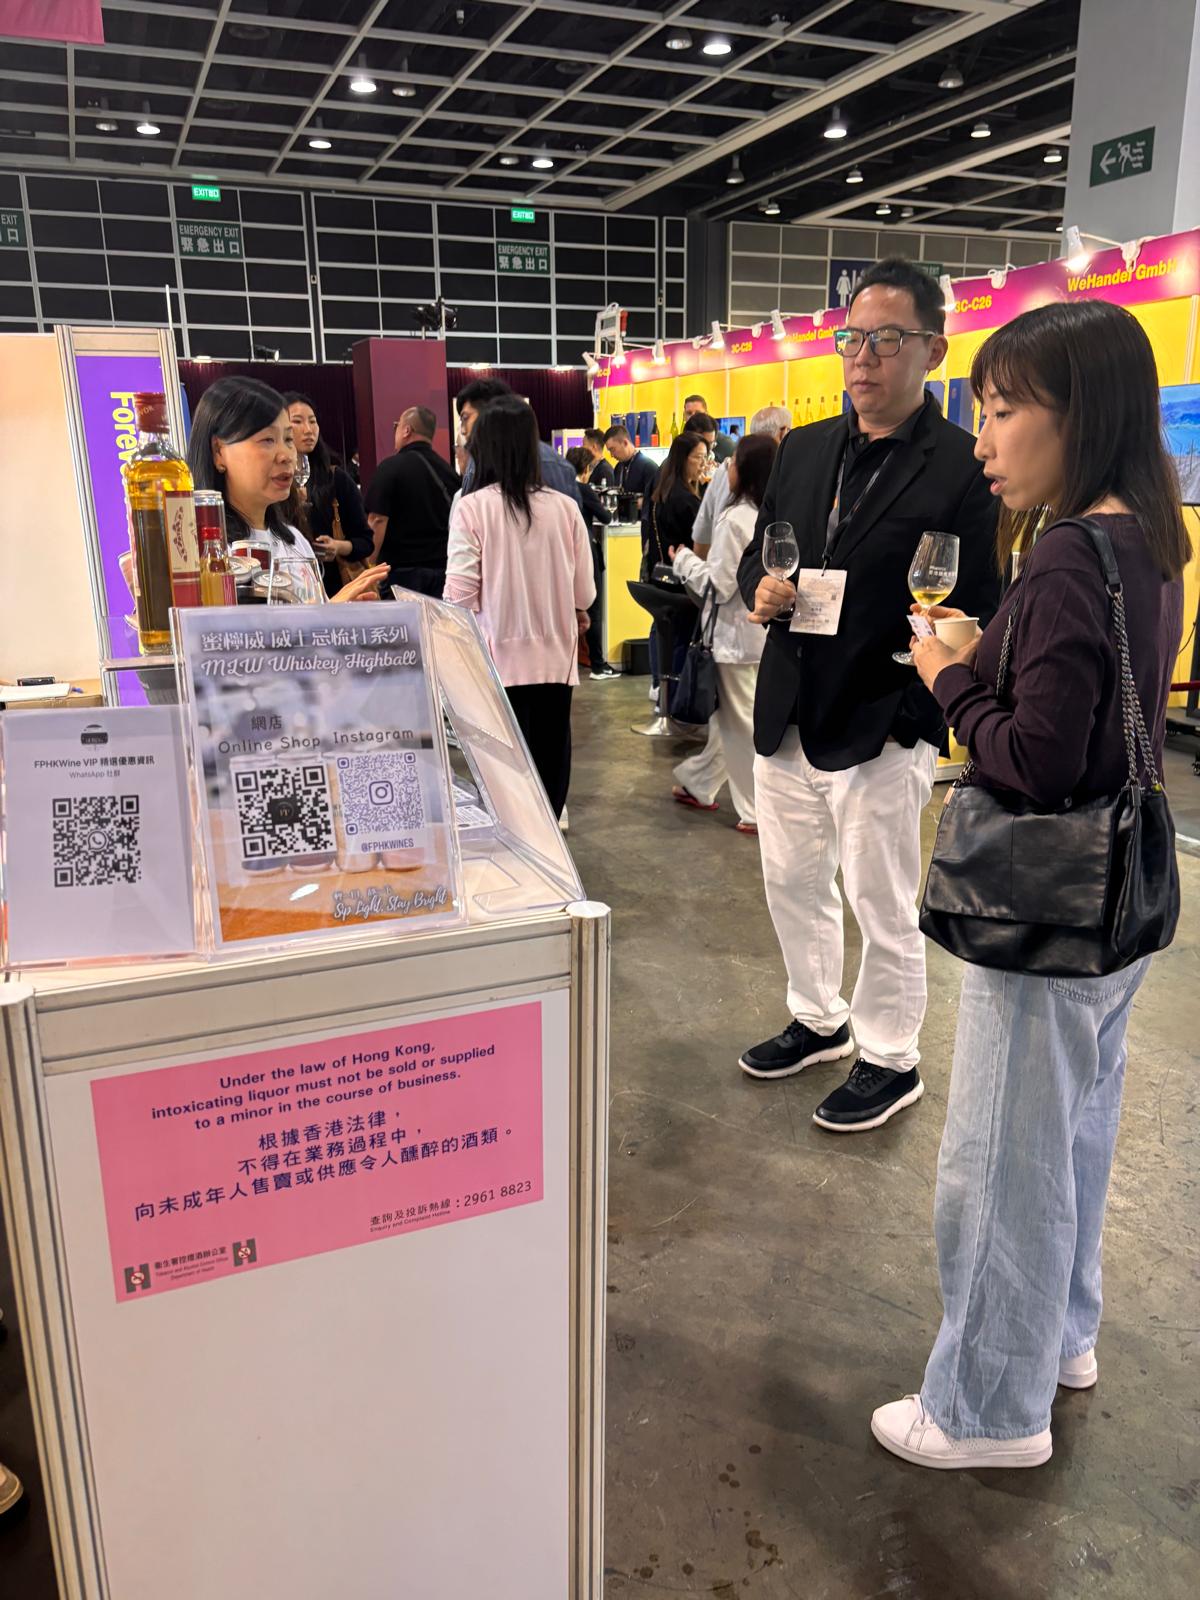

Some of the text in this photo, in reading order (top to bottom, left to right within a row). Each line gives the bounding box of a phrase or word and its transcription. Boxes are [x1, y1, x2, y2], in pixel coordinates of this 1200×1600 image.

[193, 187, 208, 197] EXIT
[1, 213, 17, 225] EXIT
[179, 224, 239, 238] EMERGENCY EXIT
[180, 236, 240, 255] 緊急出口
[498, 244, 548, 257] EMERGENCY EXIT
[498, 255, 548, 271] 緊急出口
[1067, 256, 1178, 293] WeHandel GmbH
[955, 294, 993, 314] 3C-C26
[200, 649, 417, 677] MLW Whiskey Highball
[251, 714, 282, 731] 網店
[218, 729, 414, 754] Online Shop Instagram
[34, 758, 81, 769] FPHKWine
[83, 757, 98, 767] VIP
[69, 770, 105, 779] WhatsApp
[361, 838, 414, 853] @FPHKWINES
[386, 895, 411, 913] Stay
[414, 885, 447, 911] Bright
[219, 1042, 436, 1089] Under the law of Hong Kong,
[152, 1044, 495, 1119] intoxicating liquor must not be sold or supplied
[195, 1070, 461, 1130] to a minor in the course of business.
[258, 1110, 401, 1151] 根據香港法律，
[237, 1127, 422, 1176] 不得在業務過程中，
[464, 1189, 496, 1207] 2961
[500, 1180, 532, 1198] 8823
